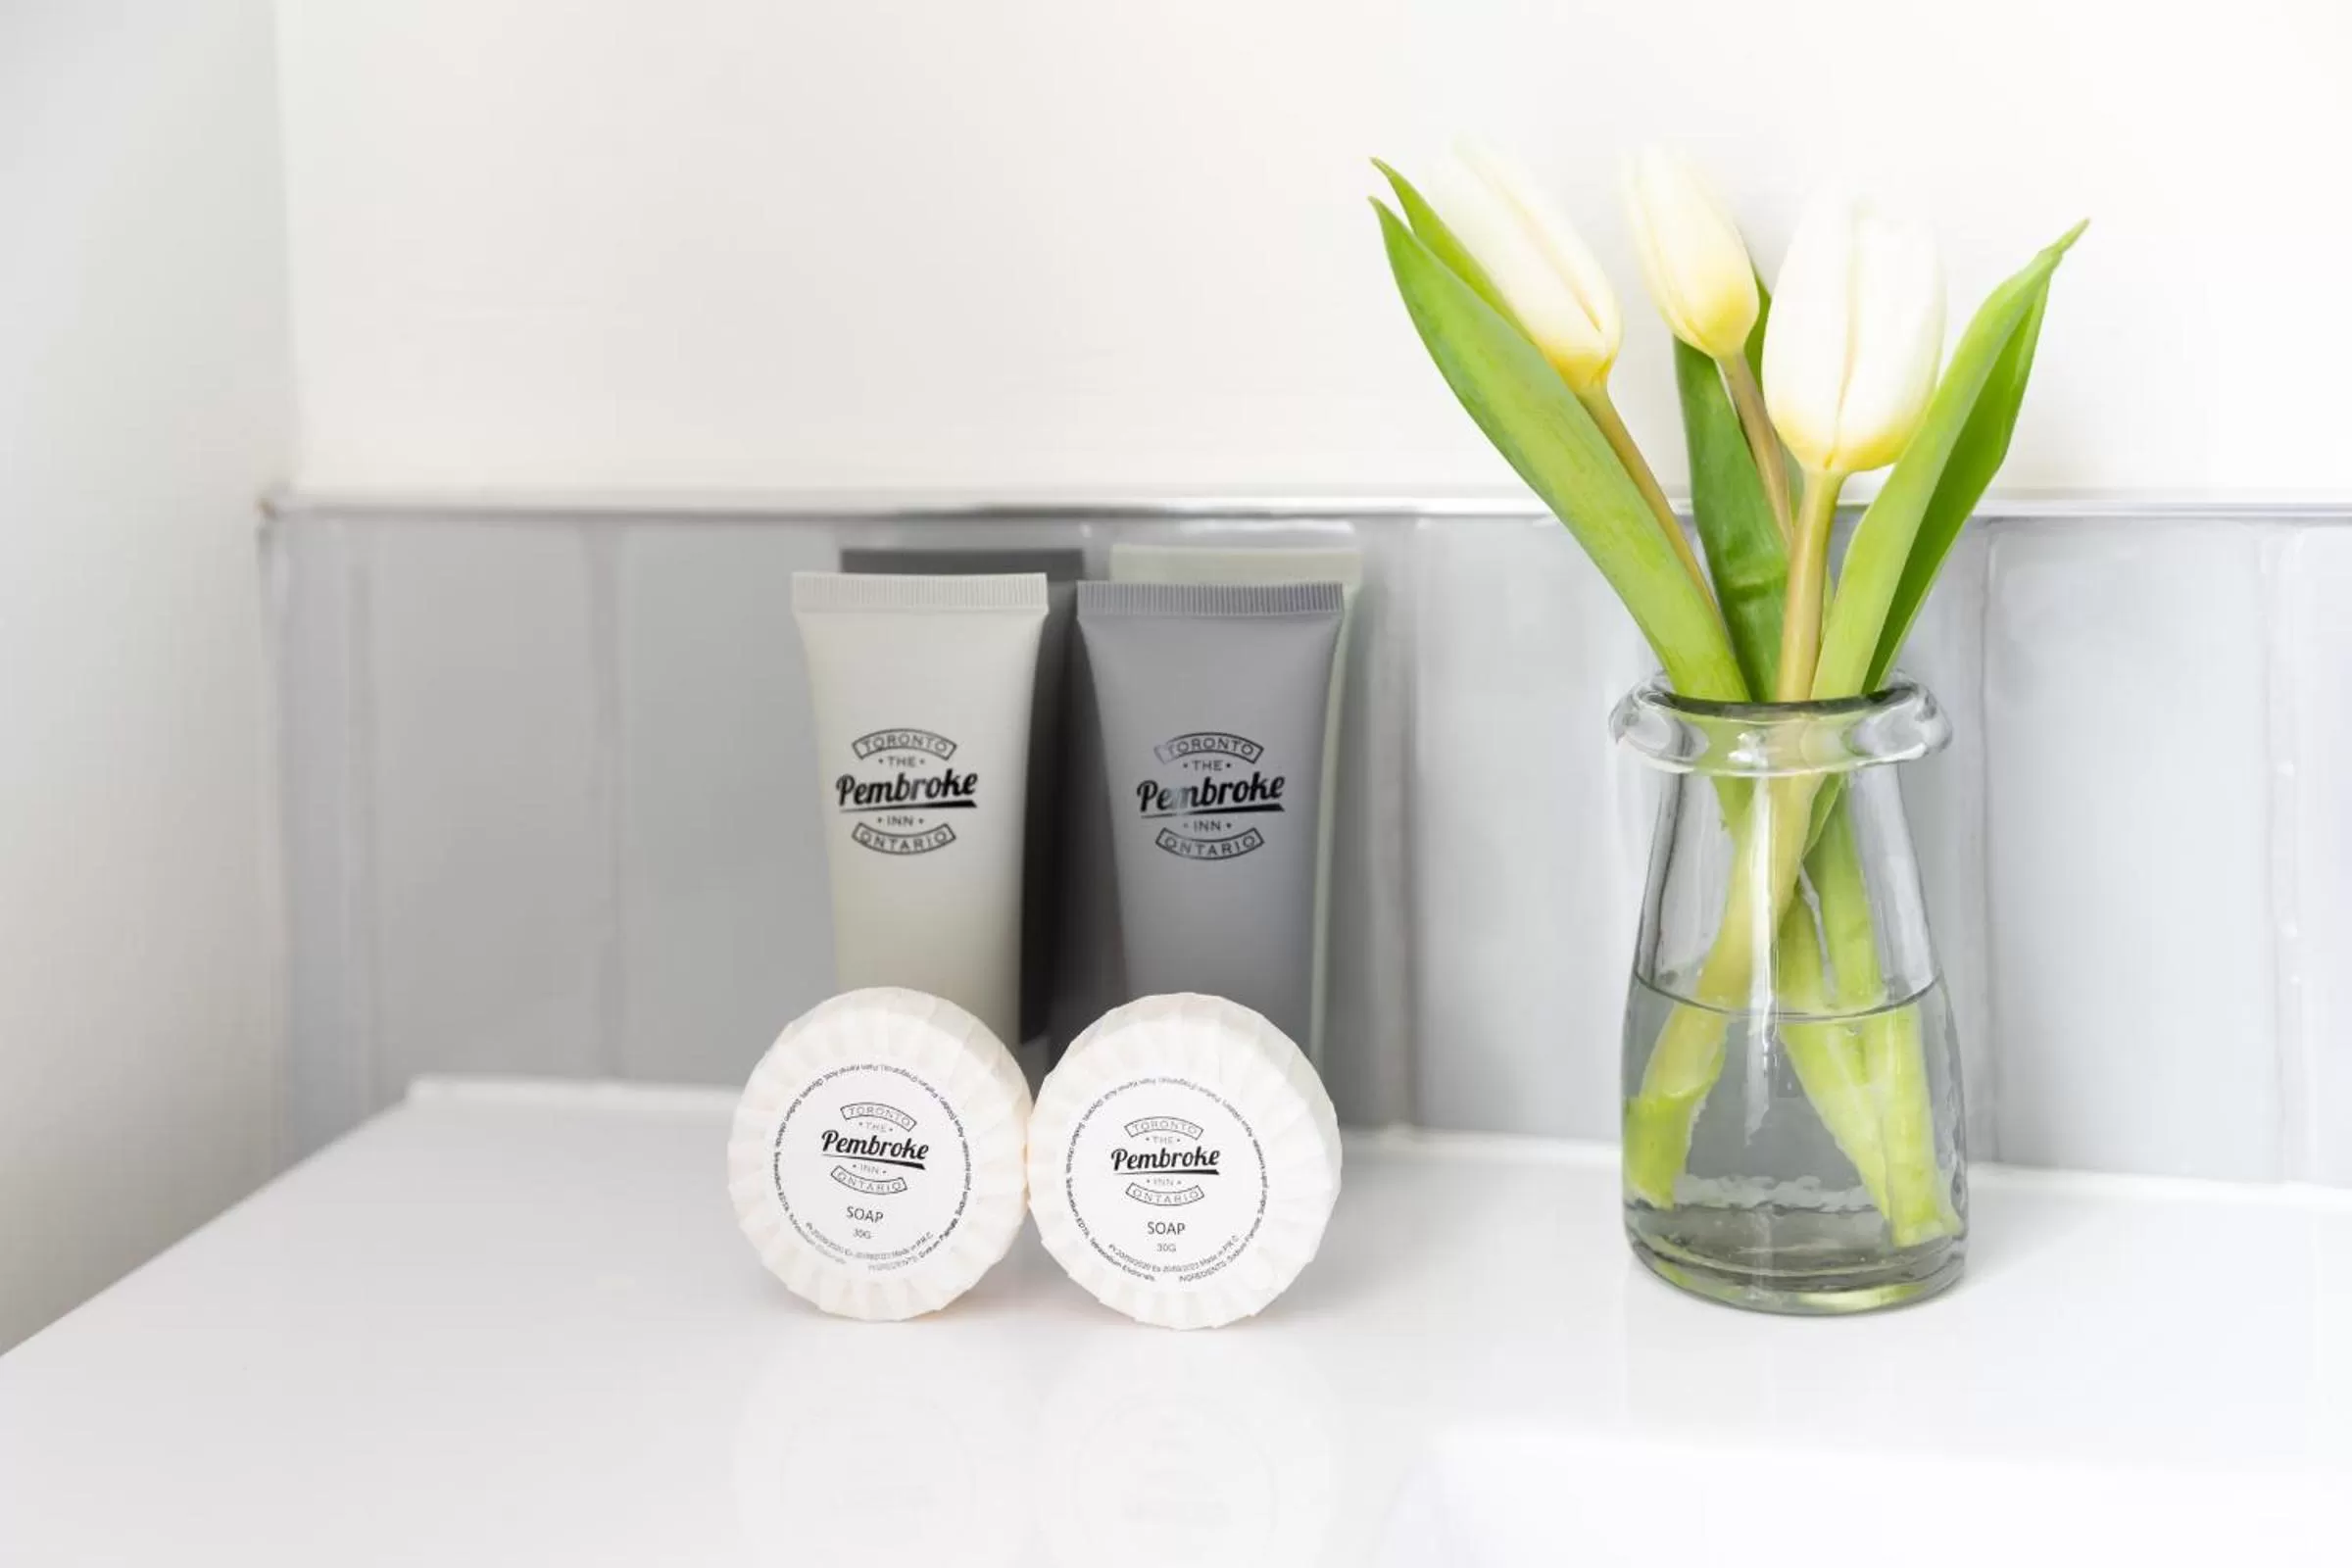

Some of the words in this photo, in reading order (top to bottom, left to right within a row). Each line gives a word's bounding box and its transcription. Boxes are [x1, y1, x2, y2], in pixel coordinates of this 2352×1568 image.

[862, 734, 947, 753] TORONTO
[1166, 737, 1253, 756] TORONTO
[888, 757, 915, 767] THE
[1192, 760, 1223, 771] THE
[836, 768, 978, 806] Pembroke
[1137, 771, 1285, 812] Pembroke
[887, 815, 913, 826] INN
[1194, 820, 1221, 831] INN
[860, 830, 947, 851] ONTARIO
[1165, 835, 1255, 856] ONTARIO
[849, 1106, 910, 1127] TORONTO
[866, 1122, 886, 1133] THE
[1133, 1121, 1198, 1134] TORONTO
[821, 1130, 929, 1159] Pembroke
[1110, 1146, 1220, 1171] Pembroke
[859, 1163, 879, 1174] INN
[836, 1171, 902, 1192] ONTARIO
[1133, 1189, 1199, 1203] ONTARIO
[847, 1205, 884, 1223] SOAP
[1148, 1221, 1185, 1235] SOAP
